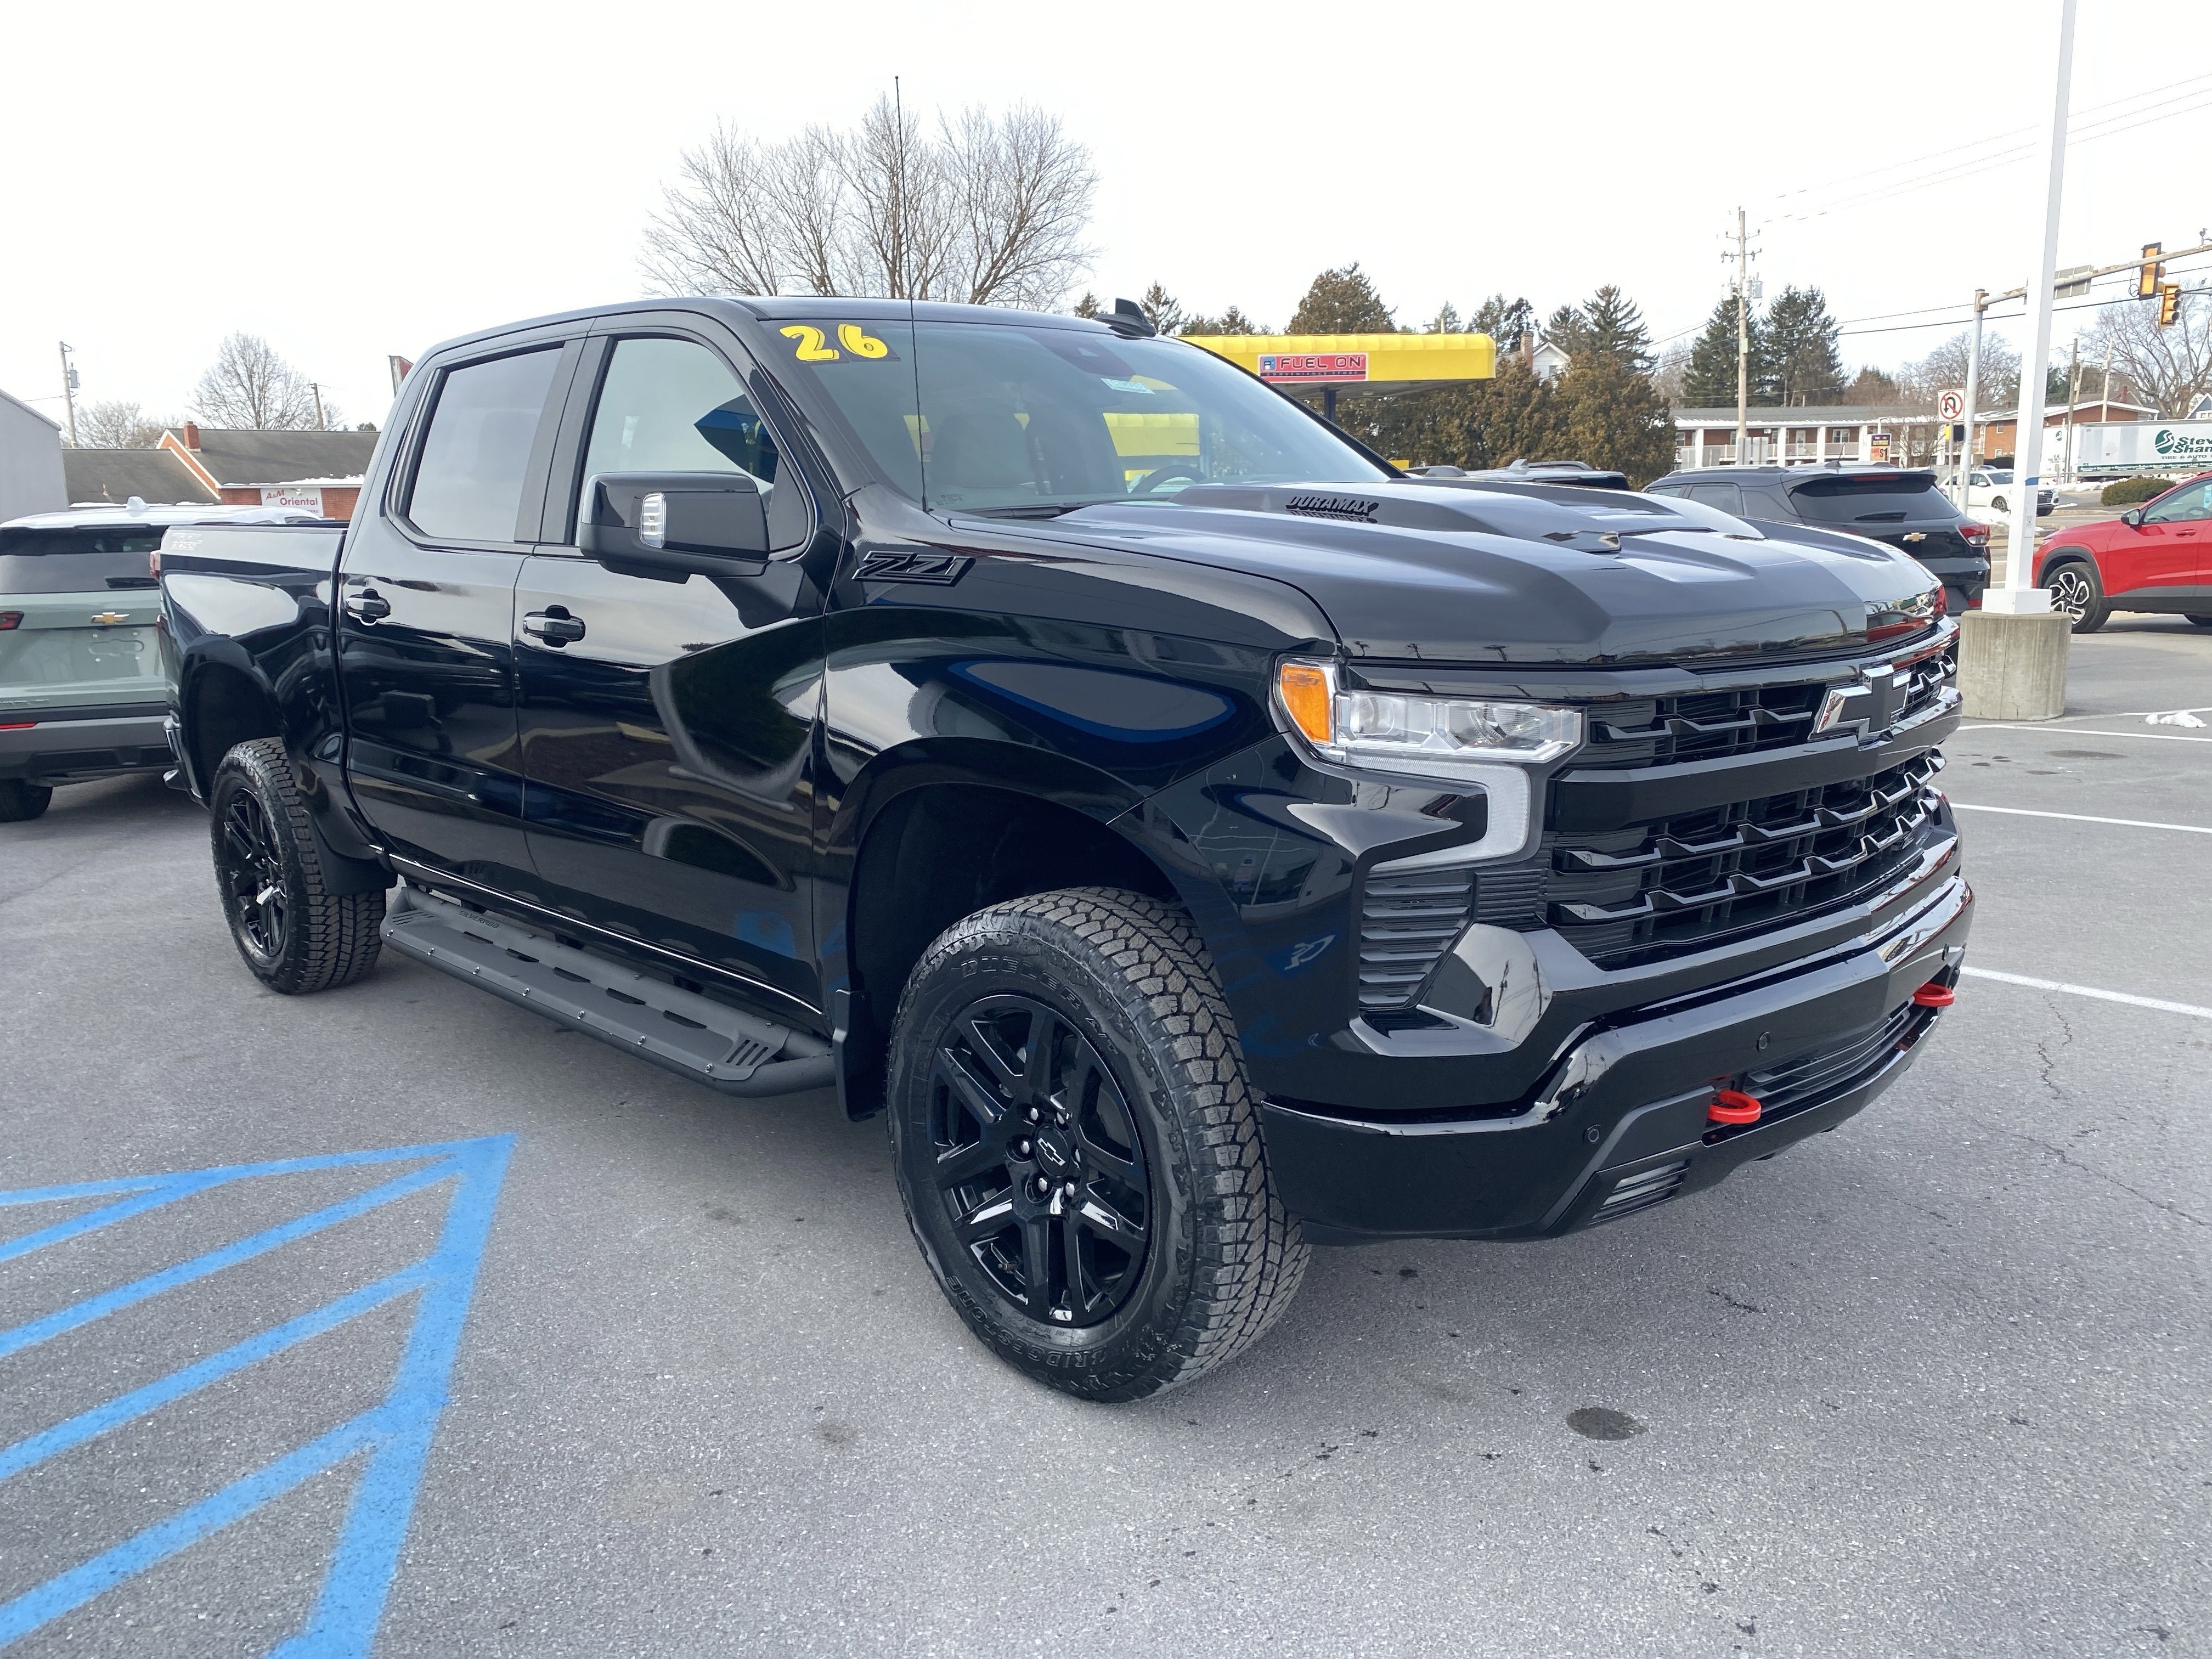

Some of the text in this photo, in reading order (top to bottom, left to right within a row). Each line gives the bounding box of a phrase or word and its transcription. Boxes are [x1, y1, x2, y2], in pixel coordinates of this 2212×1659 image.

[779, 324, 888, 362] 26
[1280, 356, 1362, 369] FUEL ON
[266, 489, 284, 500] A&M
[280, 498, 318, 506] Oriental
[1285, 495, 1379, 517] DURAMAX
[851, 550, 976, 588] Z71
[457, 911, 500, 928] SILVERADO
[945, 1275, 1106, 1368] BRIDGESTONE
